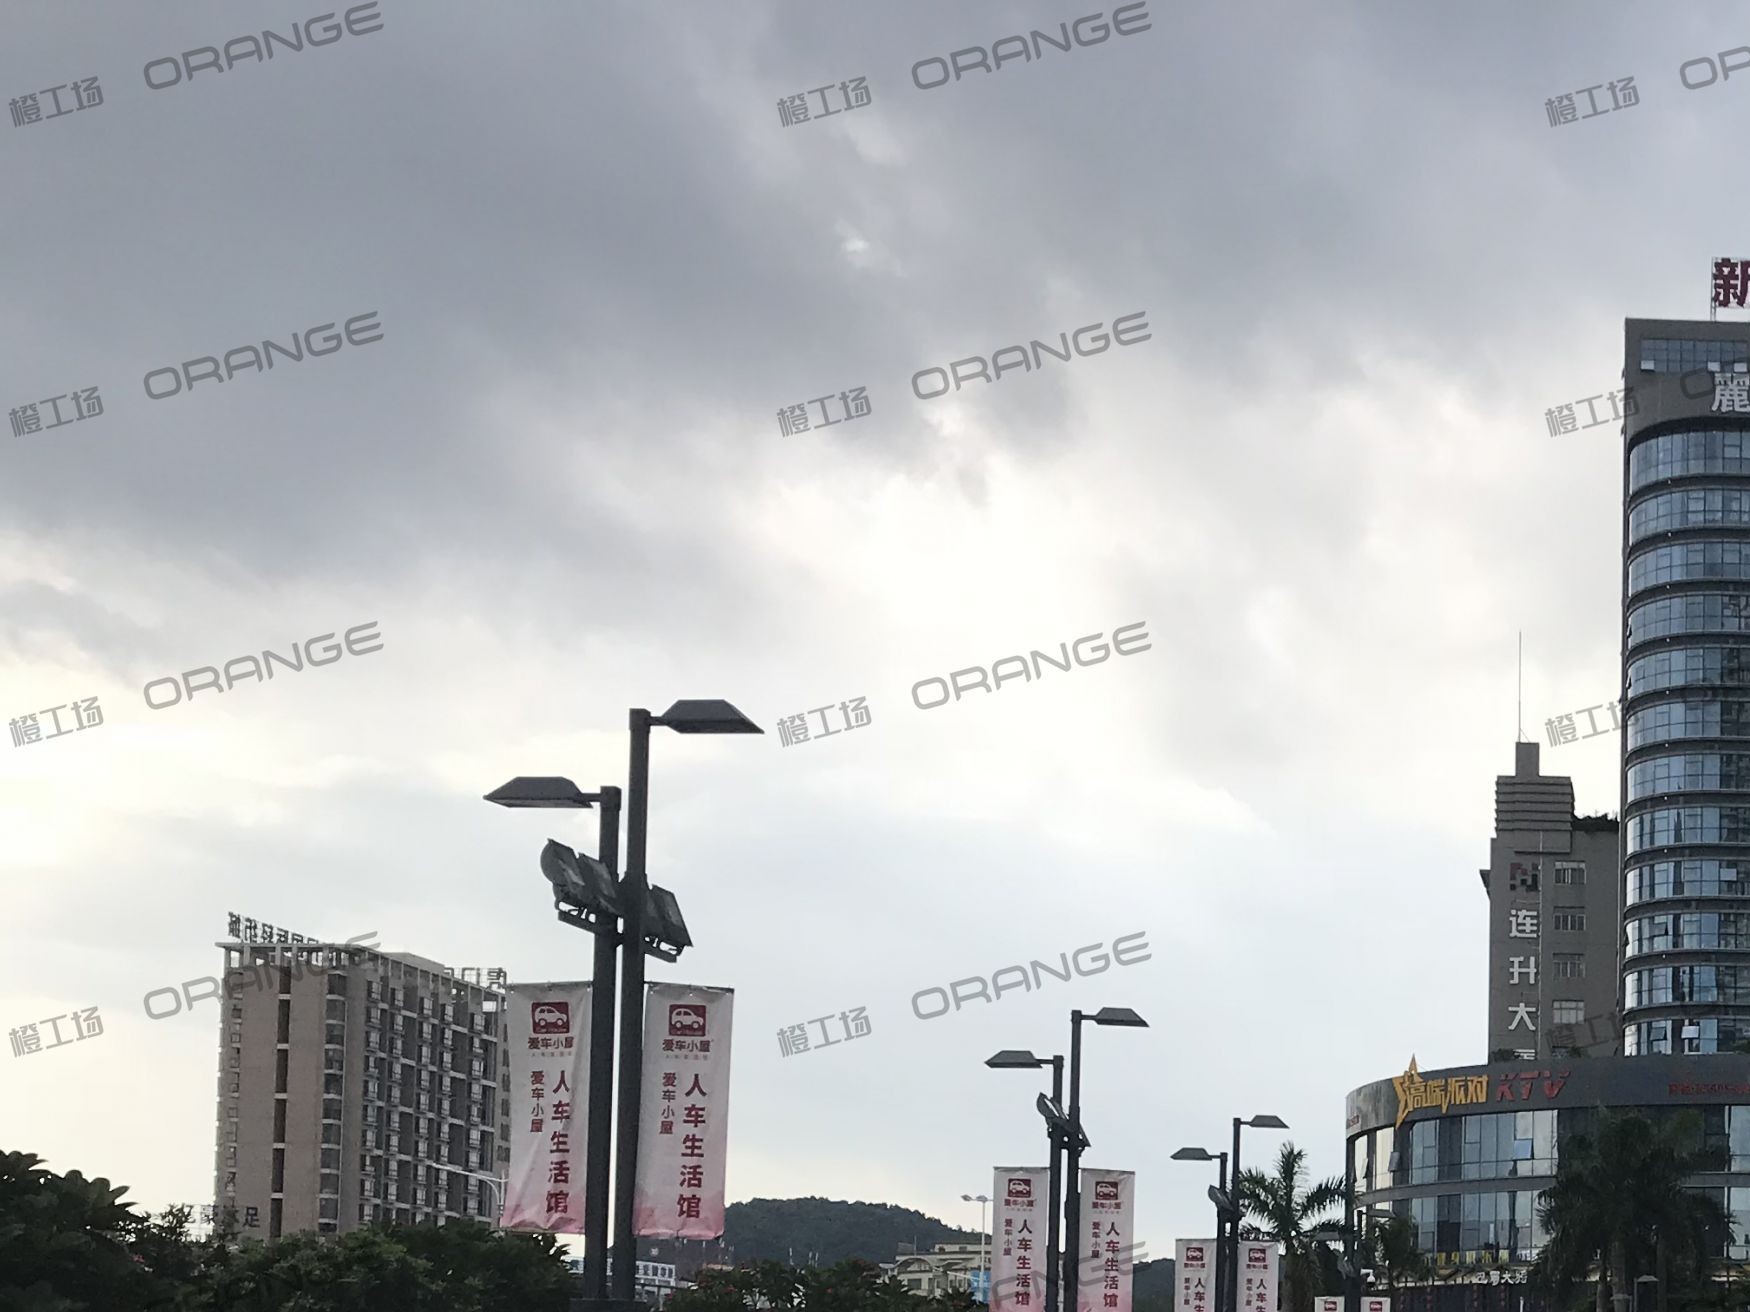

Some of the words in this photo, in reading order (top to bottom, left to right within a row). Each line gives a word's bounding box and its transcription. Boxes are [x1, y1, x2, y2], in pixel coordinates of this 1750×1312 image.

[528, 1037, 574, 1050] 爱车小屋
[662, 1039, 711, 1053] 爱车小屋
[530, 1070, 544, 1133] 爱车小屋
[659, 1072, 677, 1135] 爱车小屋
[1496, 1069, 1571, 1102] KTV
[545, 1070, 571, 1215] 人车生活馆
[677, 1073, 708, 1219] 人车生活馆
[1015, 1219, 1033, 1306] 人车生活馆
[1103, 1222, 1120, 1308] 人车生活馆
